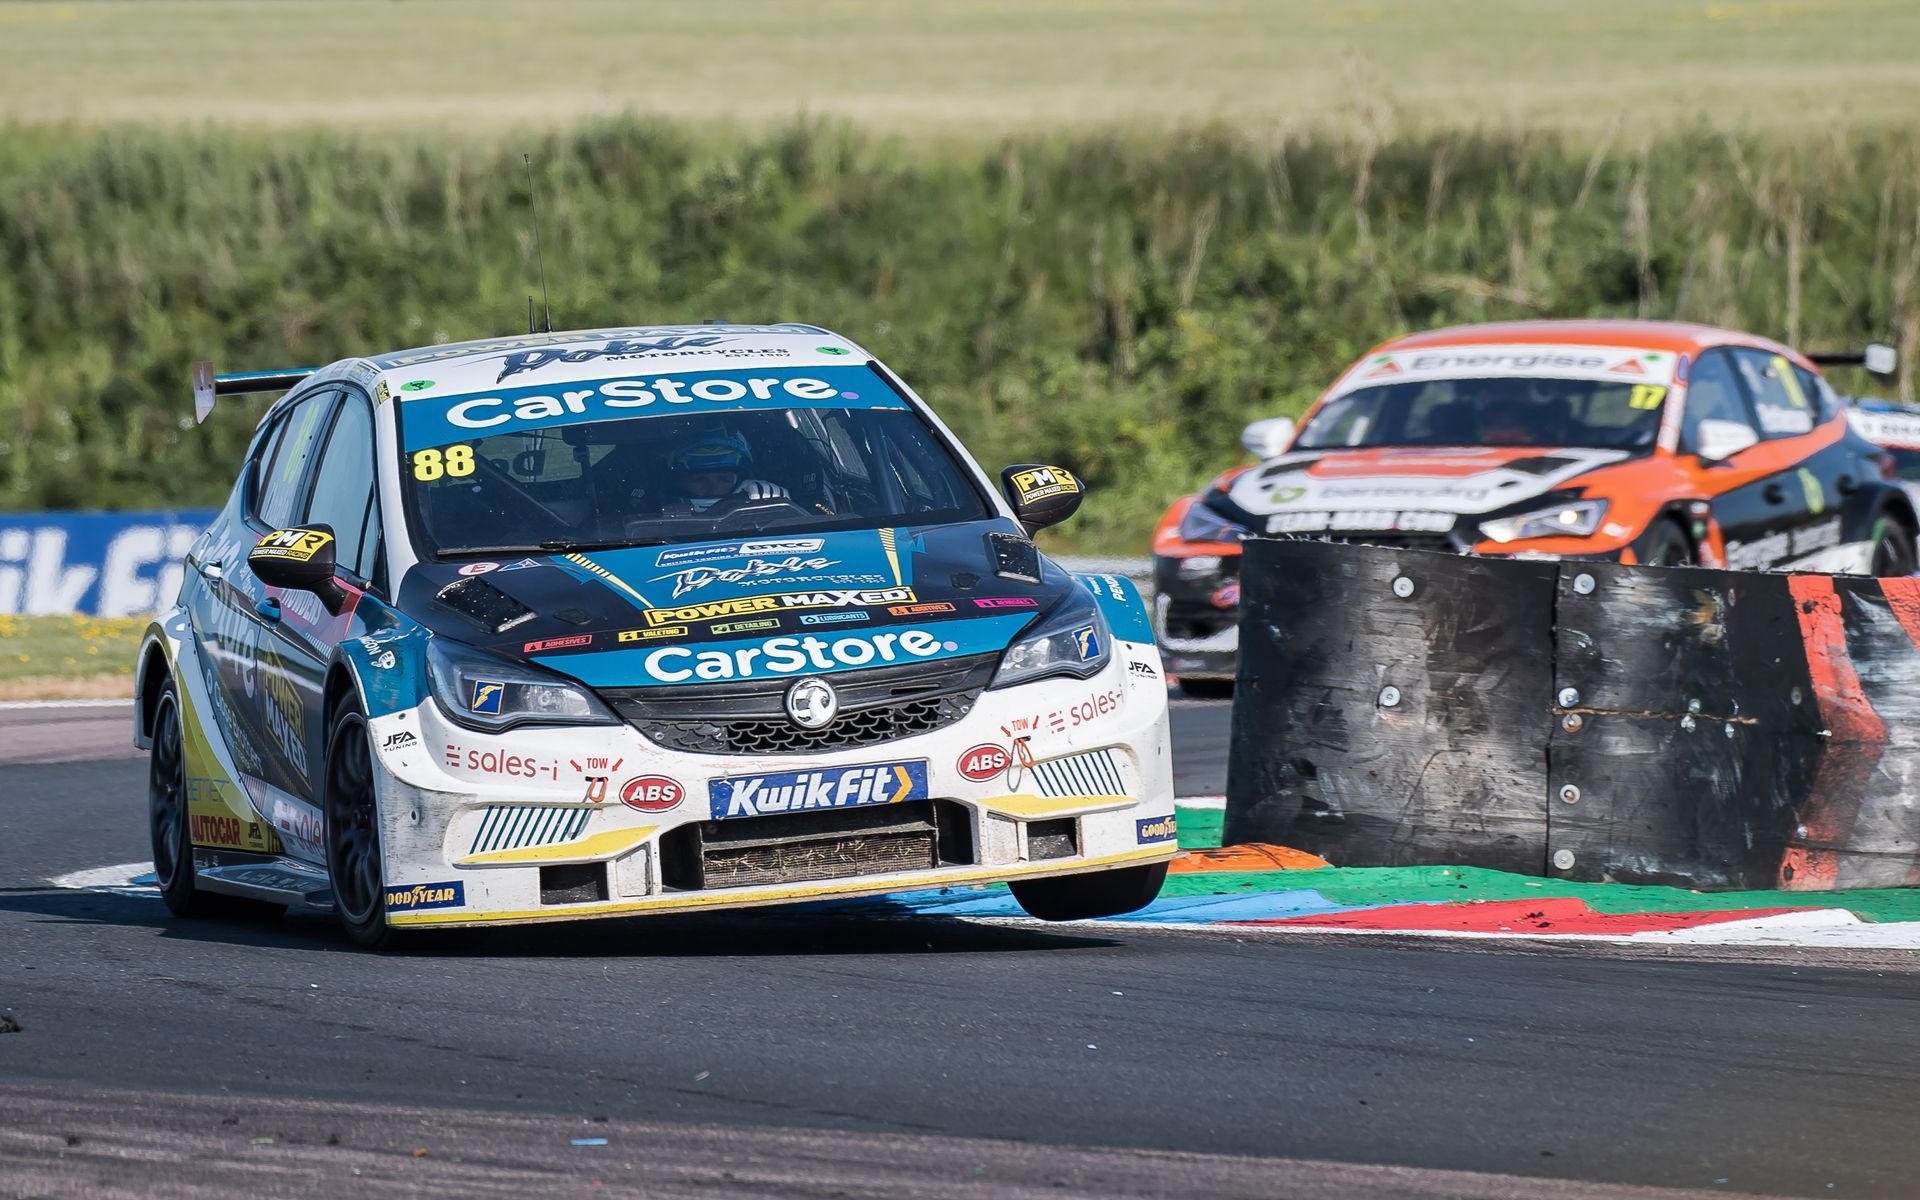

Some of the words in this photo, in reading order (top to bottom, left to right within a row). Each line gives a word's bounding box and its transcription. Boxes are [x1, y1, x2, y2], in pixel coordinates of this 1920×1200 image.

[604, 348, 789, 362] MOTORCYCLES
[1411, 355, 1605, 371] Energise
[1630, 385, 1667, 410] 17
[413, 444, 476, 482] 88
[1016, 468, 1073, 491] PMR
[1025, 489, 1045, 500] POWER
[259, 530, 325, 549] PMR
[747, 542, 813, 551] BTCC
[654, 597, 779, 623] POWER
[781, 589, 909, 607] MAXED
[734, 620, 773, 630] DETAILING
[821, 612, 866, 622] LUBRICANTS
[642, 627, 680, 637] VALETING
[544, 636, 587, 648] ADHESIVES
[1128, 661, 1156, 674] JFA
[1011, 718, 1029, 731] TOW
[383, 731, 417, 747] JFA
[384, 741, 418, 753] TUNING
[468, 749, 558, 780] sales-i
[587, 757, 608, 769] TOW
[966, 752, 1006, 773] ABS
[629, 784, 676, 802] ABS
[191, 815, 242, 846] AUTOCAR
[386, 887, 455, 906] OODYEAR
